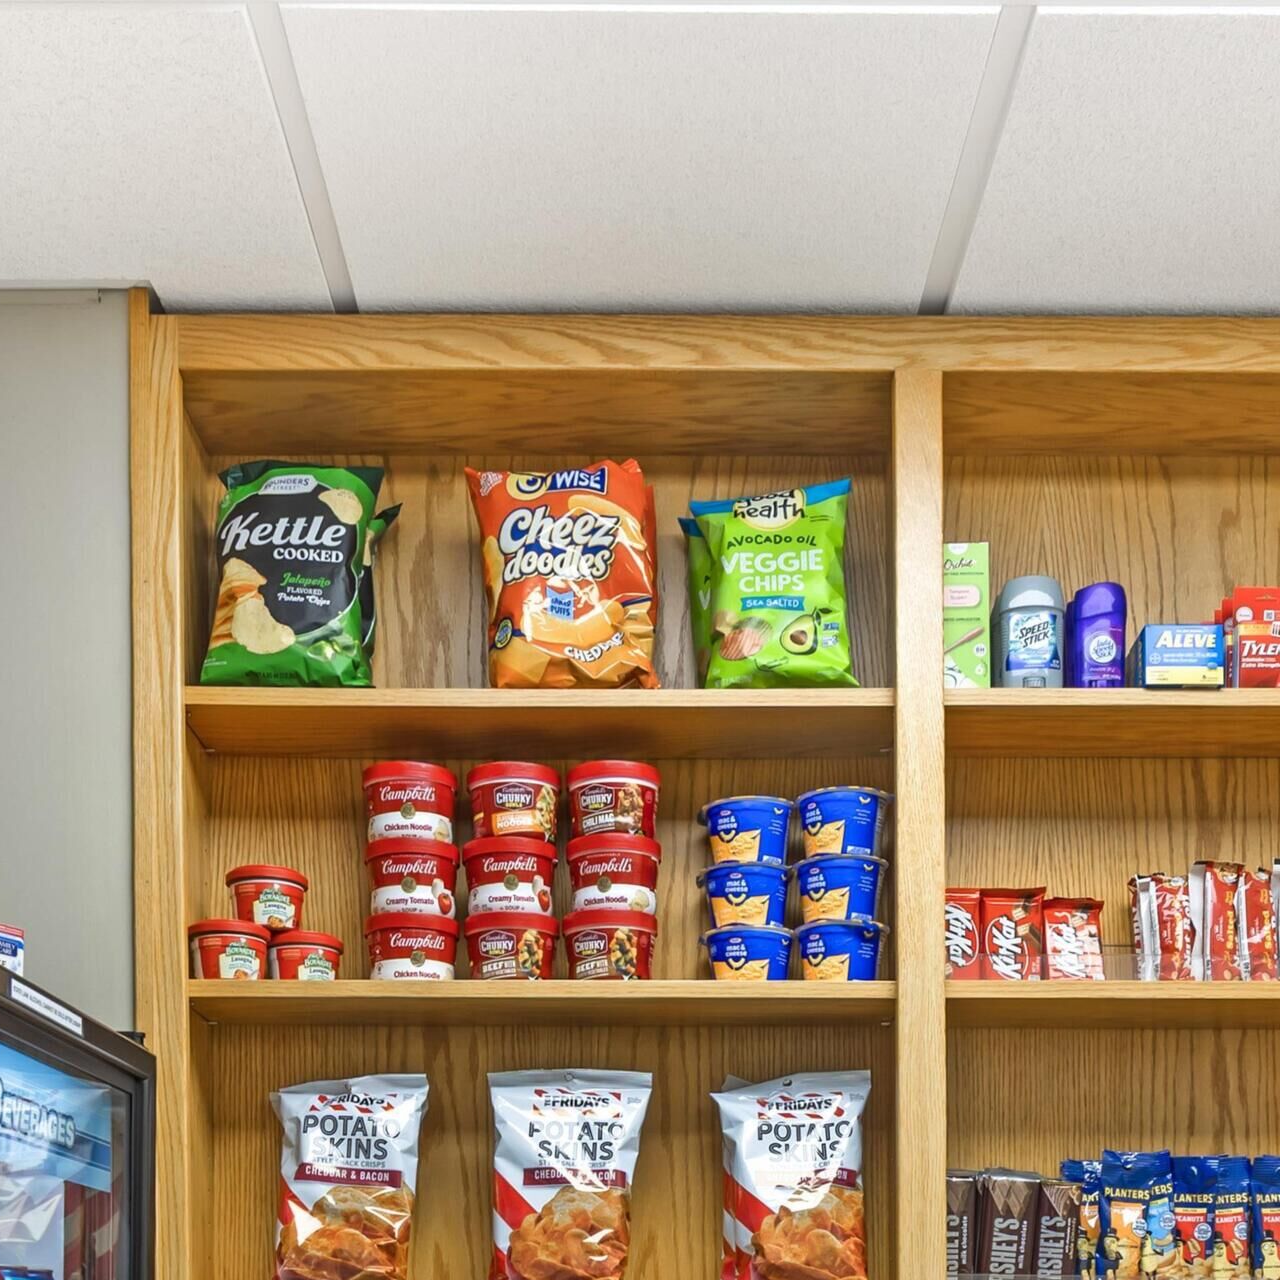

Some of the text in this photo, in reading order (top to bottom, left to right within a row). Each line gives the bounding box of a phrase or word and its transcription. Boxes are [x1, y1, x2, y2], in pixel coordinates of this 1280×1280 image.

[555, 468, 603, 492] WISE
[734, 499, 805, 520] health
[221, 511, 347, 556] Kettle
[500, 506, 621, 549] Cheez
[273, 547, 345, 564] COOKED
[721, 548, 825, 574] VEGGIE
[503, 549, 613, 584] doodles
[739, 574, 805, 593] CHIPS
[1018, 620, 1050, 640] SPEED
[1022, 630, 1051, 649] STICK
[1156, 629, 1217, 650] ALEVE
[380, 785, 436, 803] Campbell's
[383, 823, 409, 832] Chicken
[382, 858, 437, 876] Campbell's
[551, 1096, 610, 1108] FRIDAYS
[302, 1114, 401, 1139] POTATO
[528, 1120, 625, 1141] POTATO
[757, 1120, 853, 1142] POTATO
[312, 1137, 388, 1161] SKINS
[537, 1139, 614, 1161] SKINS
[768, 1140, 844, 1163] SKINS
[305, 1165, 348, 1180] CHEDDAR
[360, 1171, 390, 1182] BACON
[1104, 1187, 1151, 1201] PLANTERS
[1174, 1193, 1214, 1205] LANTERS
